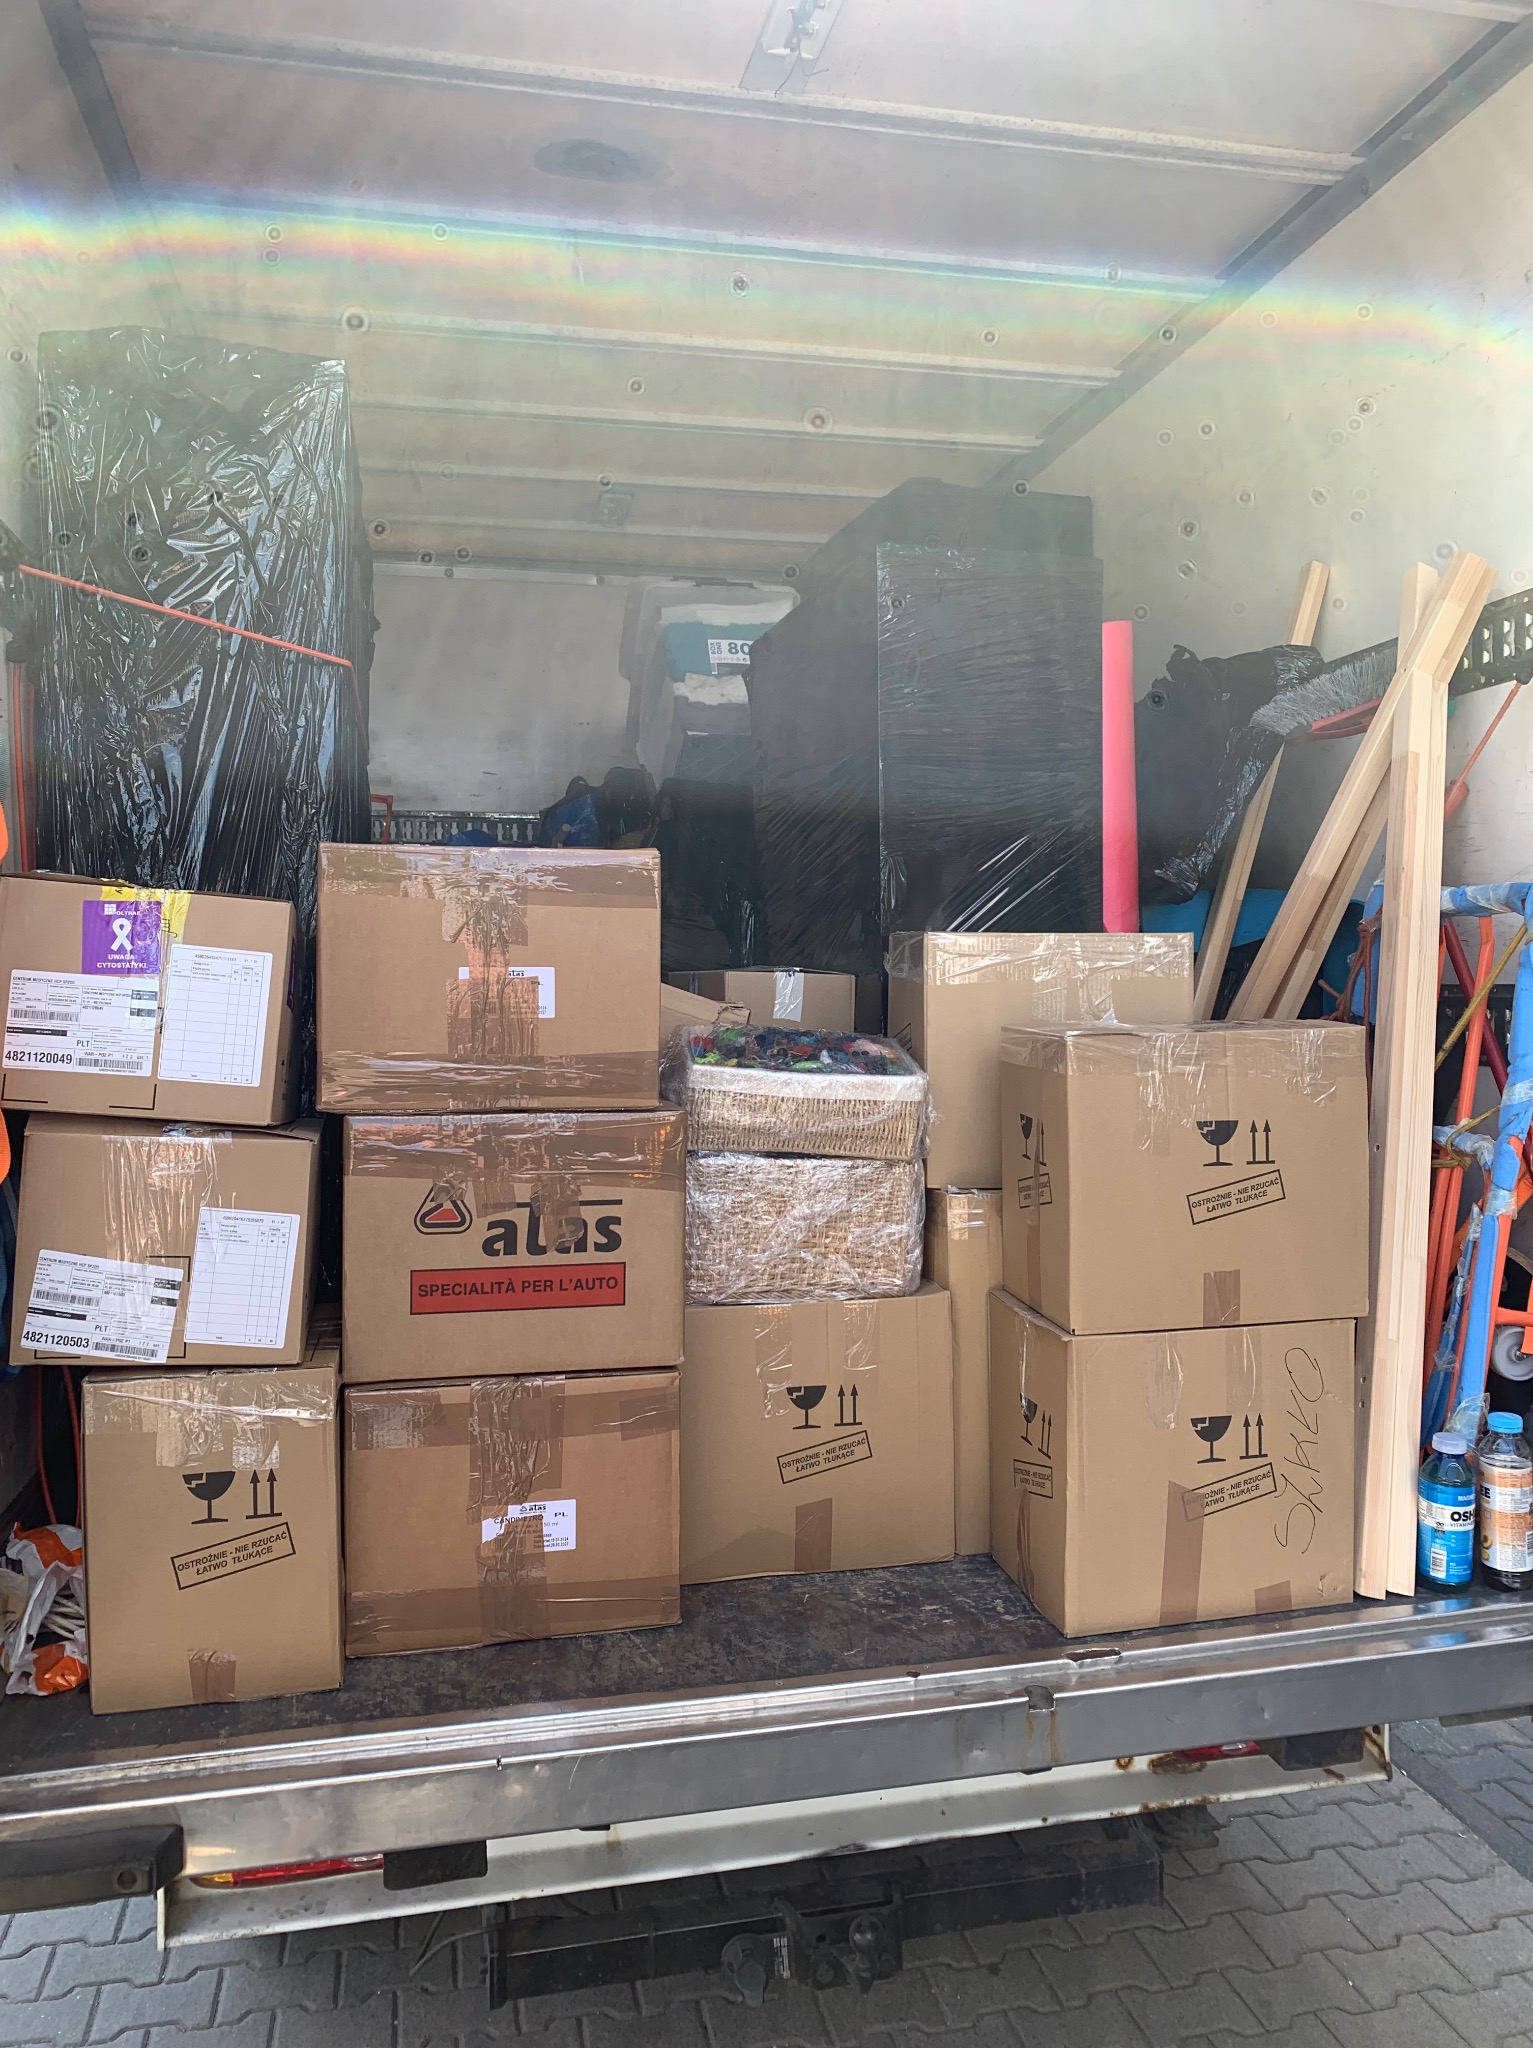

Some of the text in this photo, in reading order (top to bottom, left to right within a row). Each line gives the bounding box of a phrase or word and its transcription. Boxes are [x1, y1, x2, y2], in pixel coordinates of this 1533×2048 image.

[76, 1039, 91, 1049] PLT
[5, 1050, 73, 1065] 4821120049
[1192, 1191, 1233, 1209] OSTROŻNIE
[1237, 1186, 1250, 1197] NIE
[1250, 1176, 1280, 1193] RZUCAĆ
[1206, 1189, 1268, 1213] ŁATWO TŁUKĄCE
[481, 1199, 623, 1257] atas
[417, 1276, 619, 1298] SPECIALITÀ PER L'AUTO
[22, 1330, 90, 1349] 4821120503
[94, 1324, 109, 1333] PLT
[782, 1451, 821, 1469] OSTROŻNIE
[825, 1446, 838, 1457] NIE
[838, 1436, 867, 1454] RZUCAĆ
[795, 1449, 855, 1473] ŁATWO TŁUKĄCE
[1227, 1483, 1260, 1500] TŁUKĄCE
[1230, 1481, 1243, 1492] NIE
[1243, 1469, 1272, 1487] RZUCAĆ
[177, 1550, 229, 1572] OSTROŻNIE
[234, 1543, 250, 1555] NIE
[251, 1530, 288, 1549] RZUCAĆ
[195, 1545, 273, 1576] ŁATWO TŁUKĄCE
